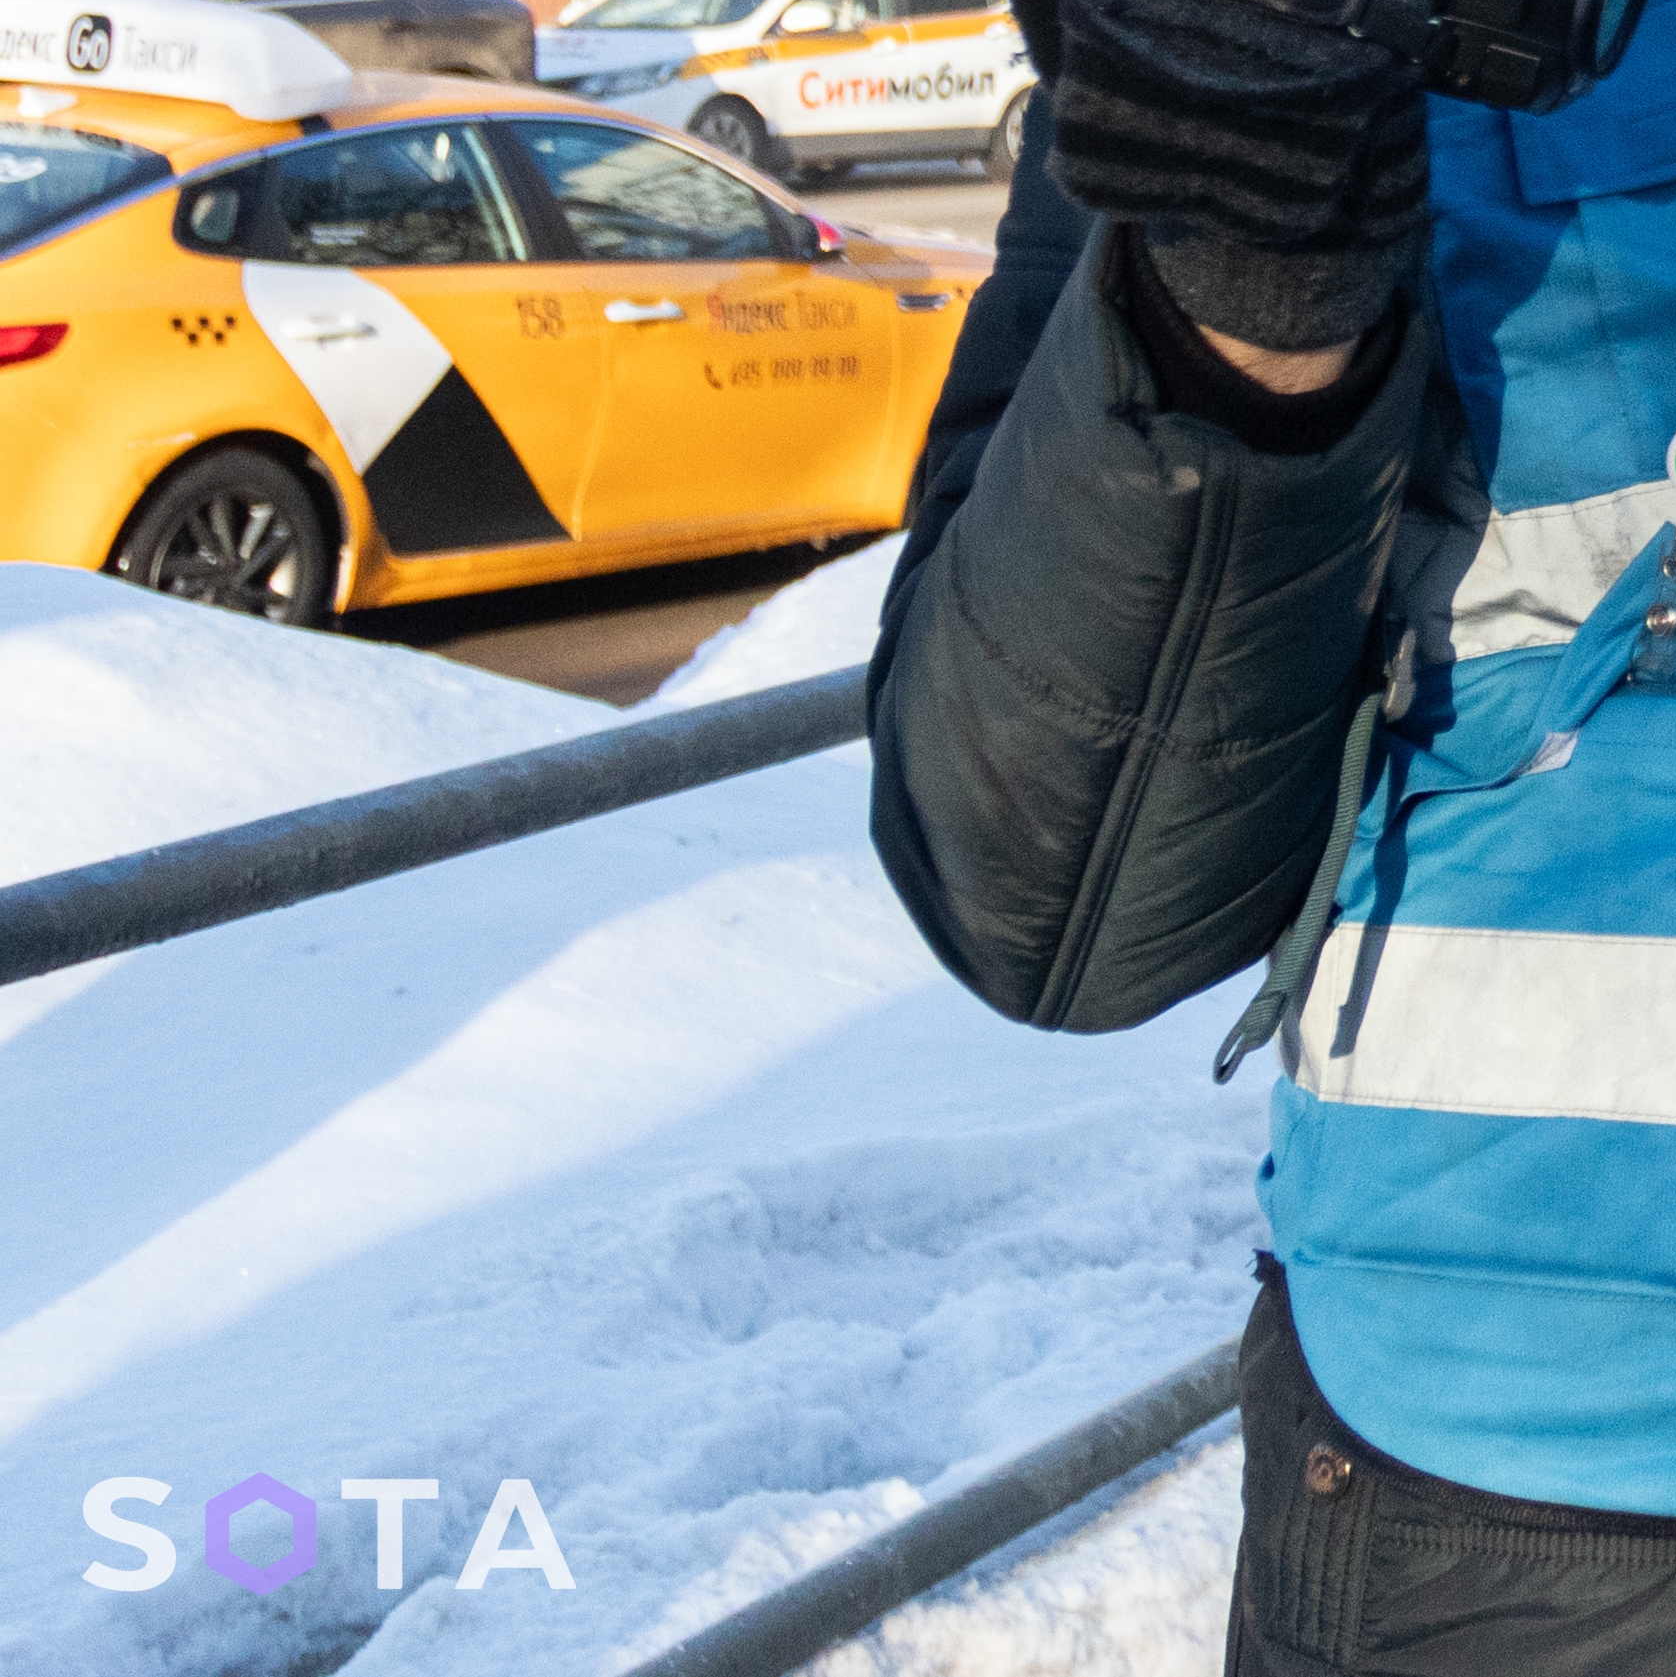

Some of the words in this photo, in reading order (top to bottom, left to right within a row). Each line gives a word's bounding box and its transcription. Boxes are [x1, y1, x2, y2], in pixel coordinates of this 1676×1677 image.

[0, 27, 58, 64] декс
[68, 16, 111, 71] Go
[123, 24, 199, 74] Такси
[799, 62, 995, 110] Ситимобил
[706, 293, 788, 335] Яндекс
